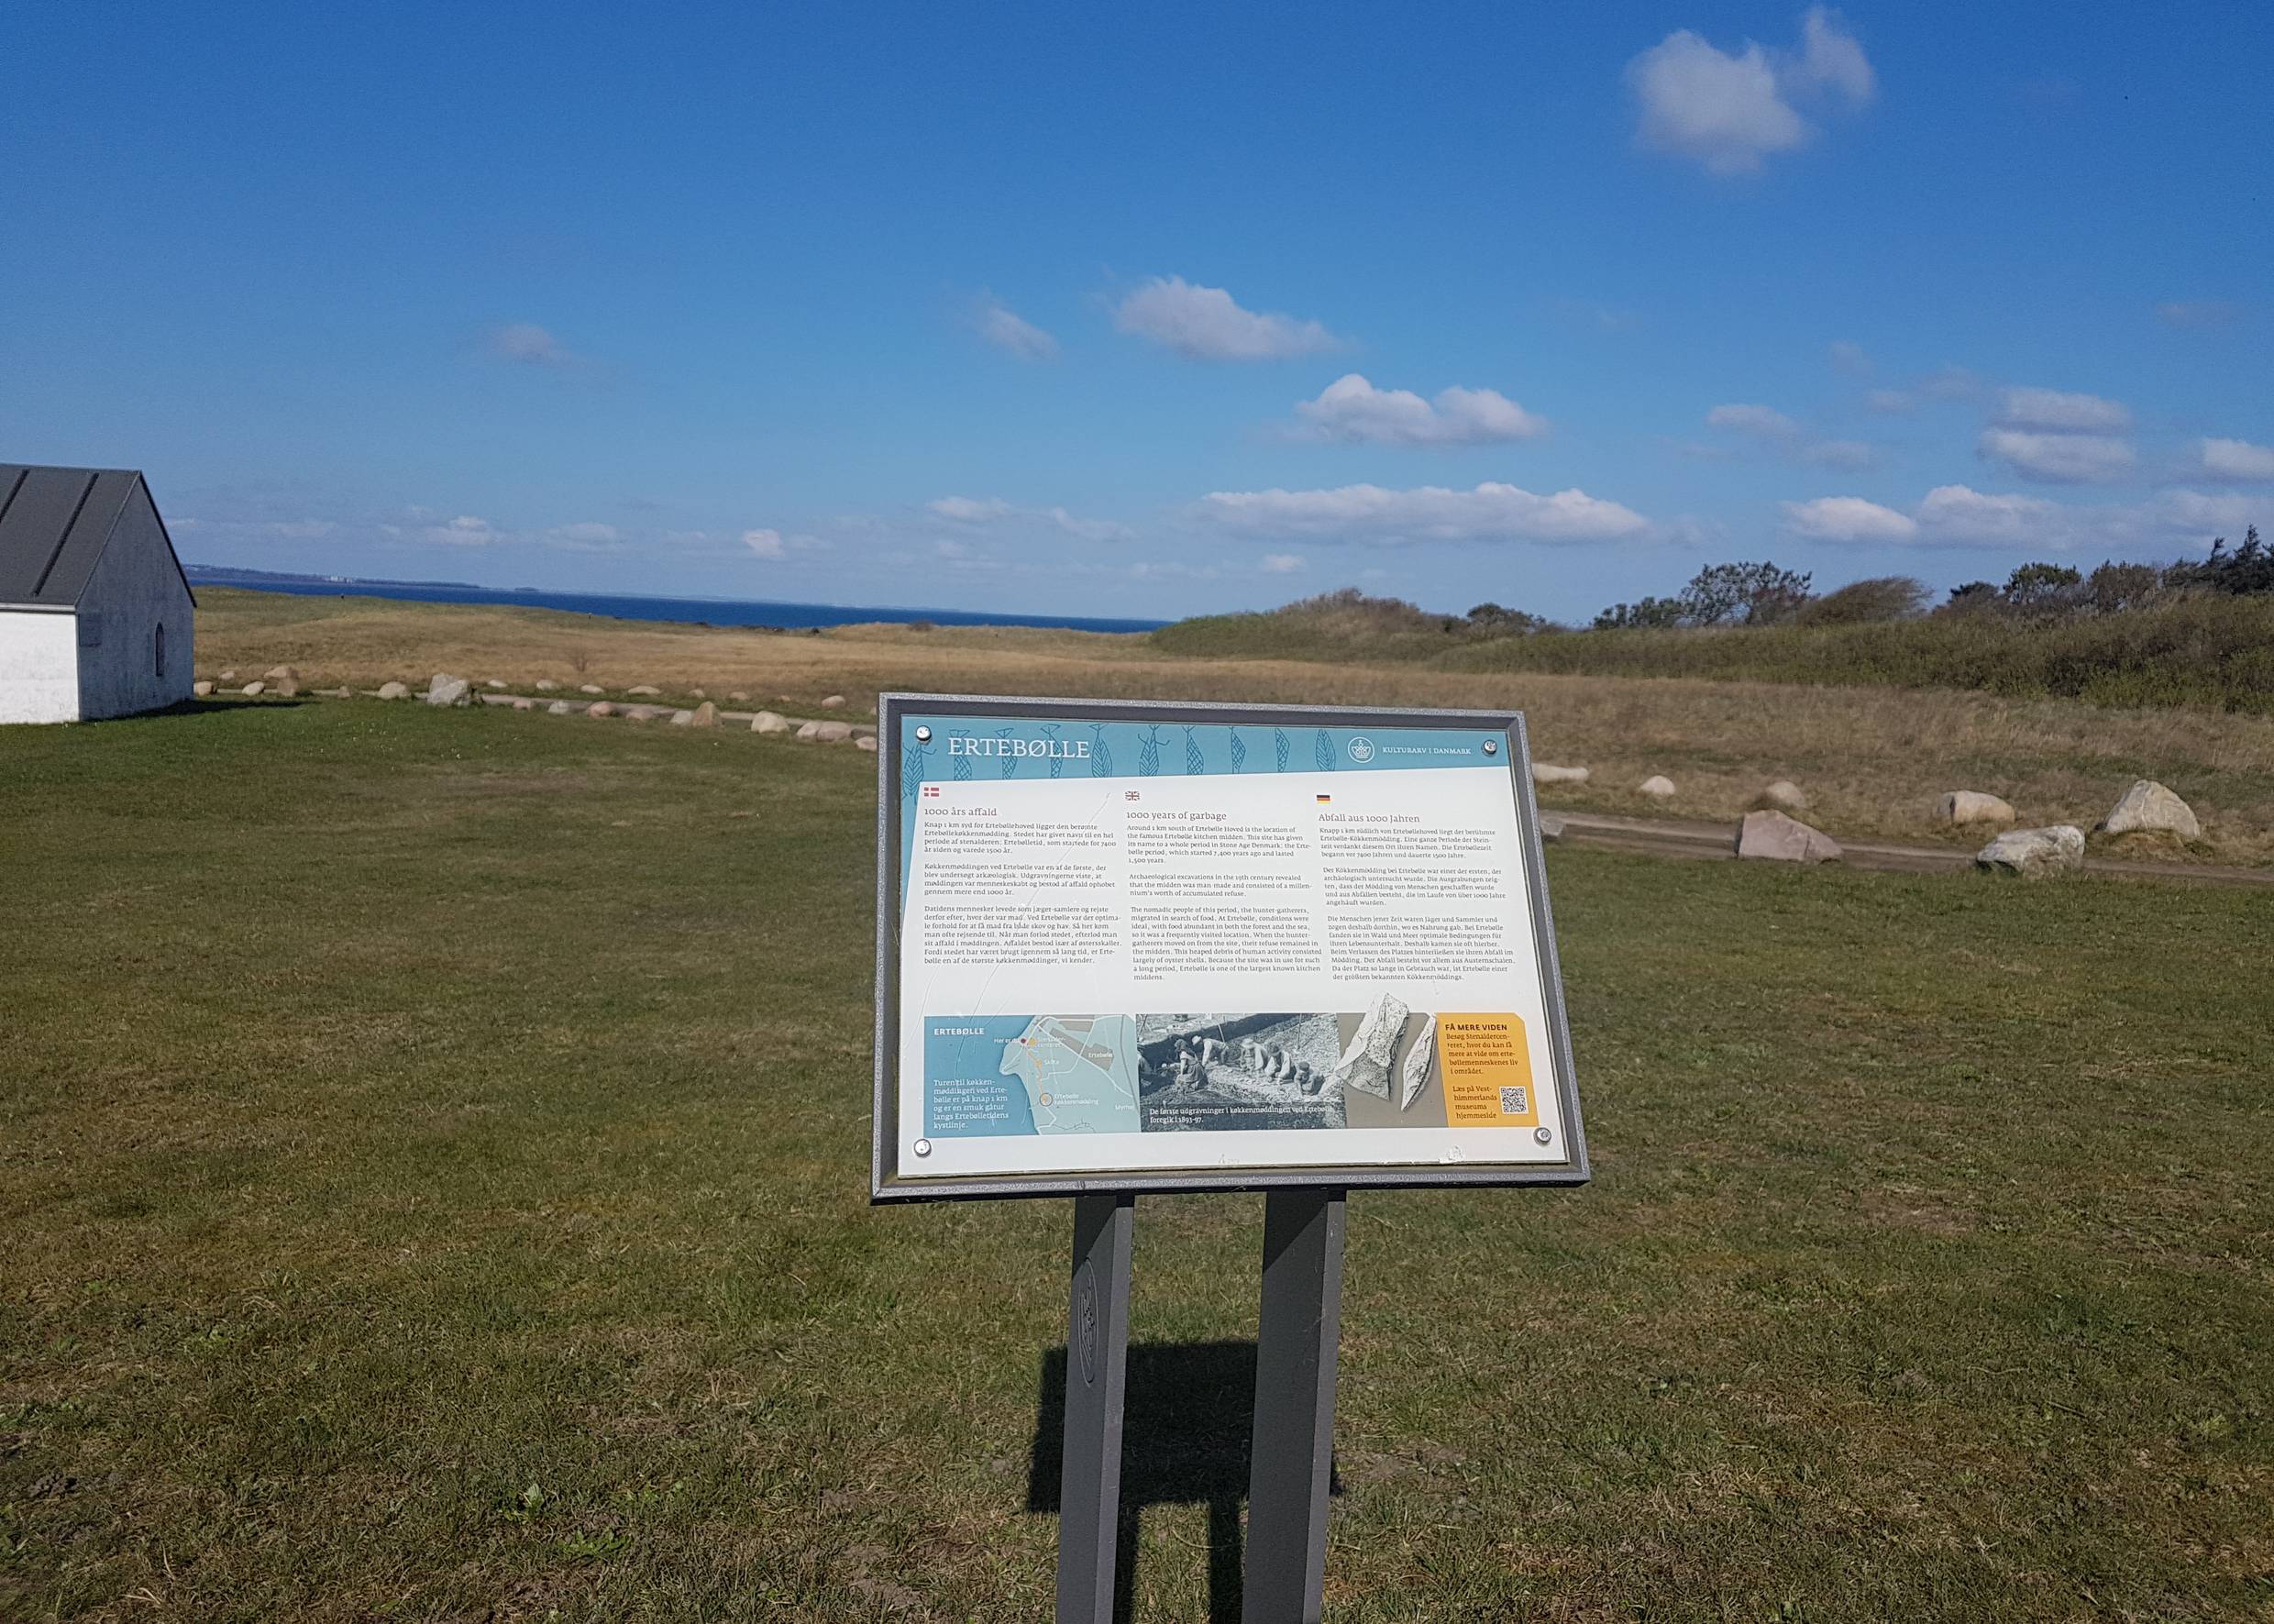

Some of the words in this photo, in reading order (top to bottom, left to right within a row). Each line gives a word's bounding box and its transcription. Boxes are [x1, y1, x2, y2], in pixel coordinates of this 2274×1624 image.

[948, 738, 1091, 758] ERTEBØLLE
[950, 807, 966, 816] års
[968, 808, 997, 816] affald
[1151, 813, 1176, 822] years
[1178, 811, 1187, 820] of
[1189, 811, 1226, 822] garbage
[1319, 813, 1346, 822] Abfall
[1390, 814, 1419, 822] Jahren
[1285, 833, 1303, 842] given
[1129, 872, 1176, 881] Archaeological
[1249, 874, 1274, 882] century
[1032, 905, 1080, 914] jæger-samlere
[1090, 905, 1108, 914] rejste
[1172, 906, 1193, 915] people
[1216, 906, 1239, 915] period,
[1252, 906, 1309, 915] hunter-gatherers,
[934, 1088, 975, 1096] møddingen
[934, 1122, 968, 1130] kystlinje.
